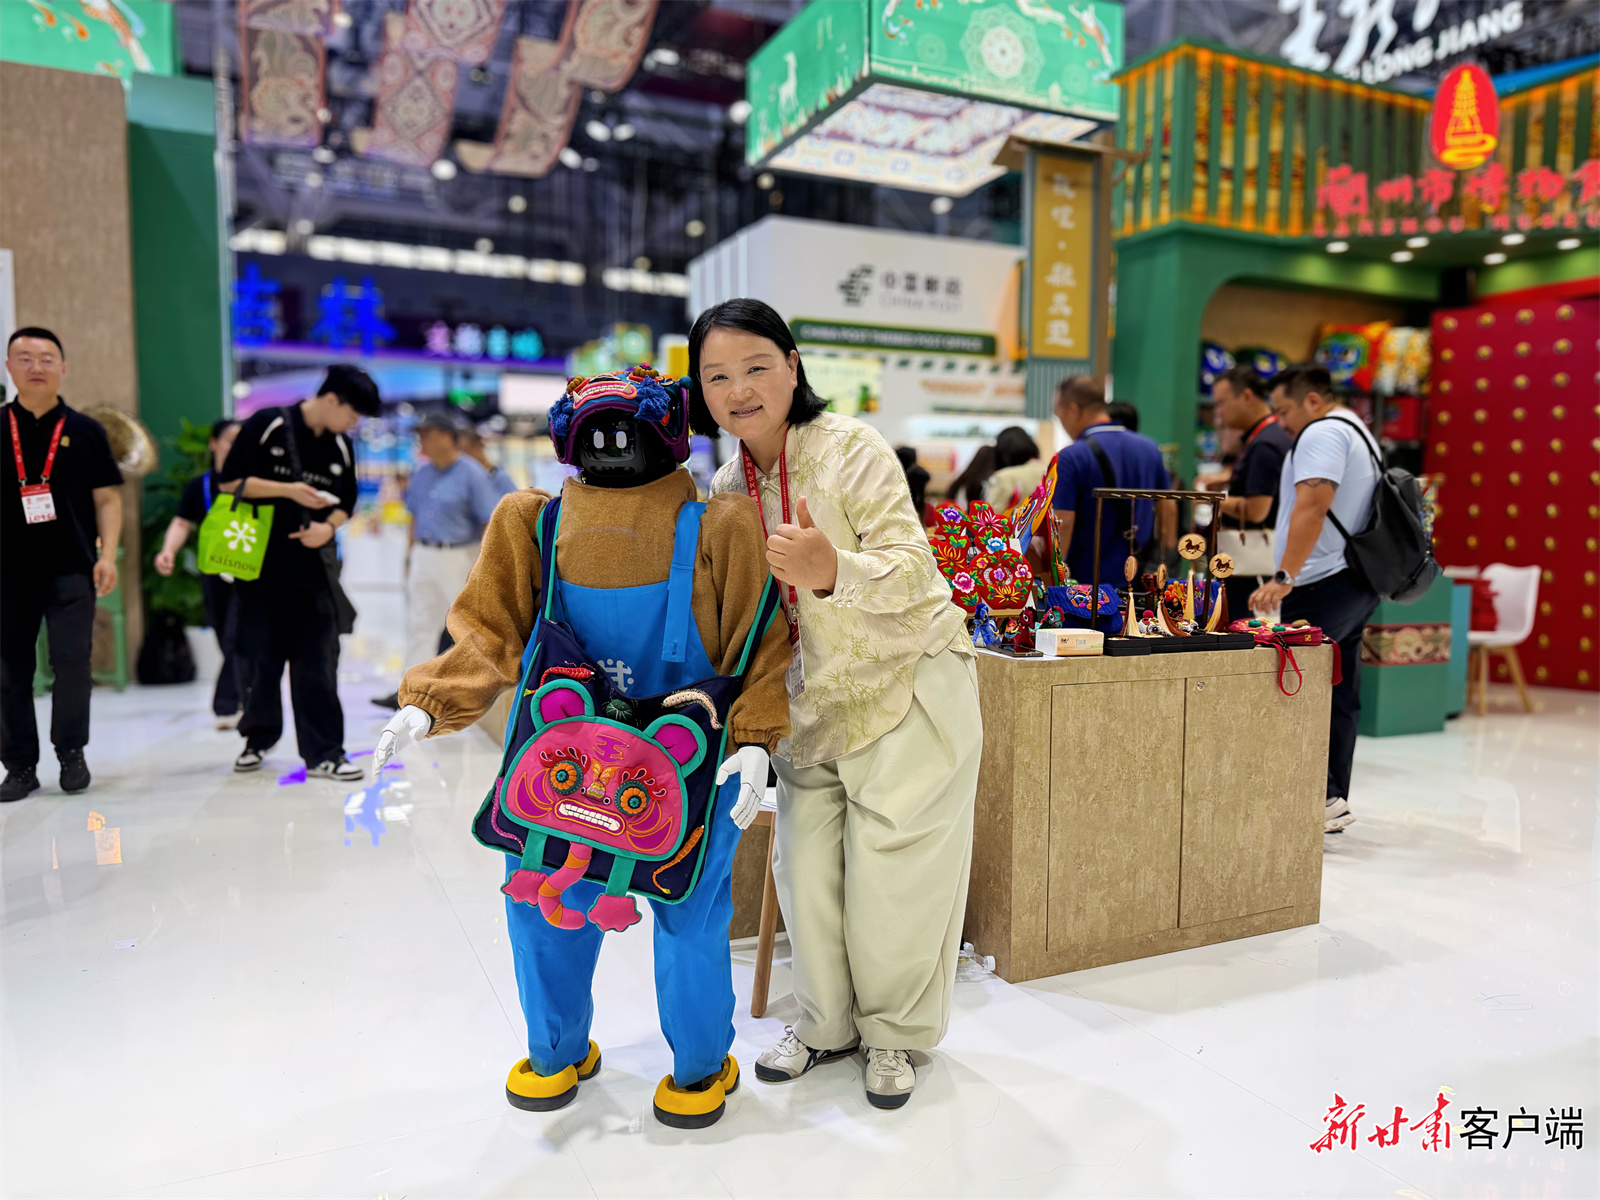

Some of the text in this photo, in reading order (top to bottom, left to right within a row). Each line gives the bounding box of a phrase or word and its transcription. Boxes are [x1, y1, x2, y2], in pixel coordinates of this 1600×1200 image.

[1362, 35, 1434, 85] LONG
[1434, 1, 1523, 61] JIANG
[230, 262, 397, 357] 吉林
